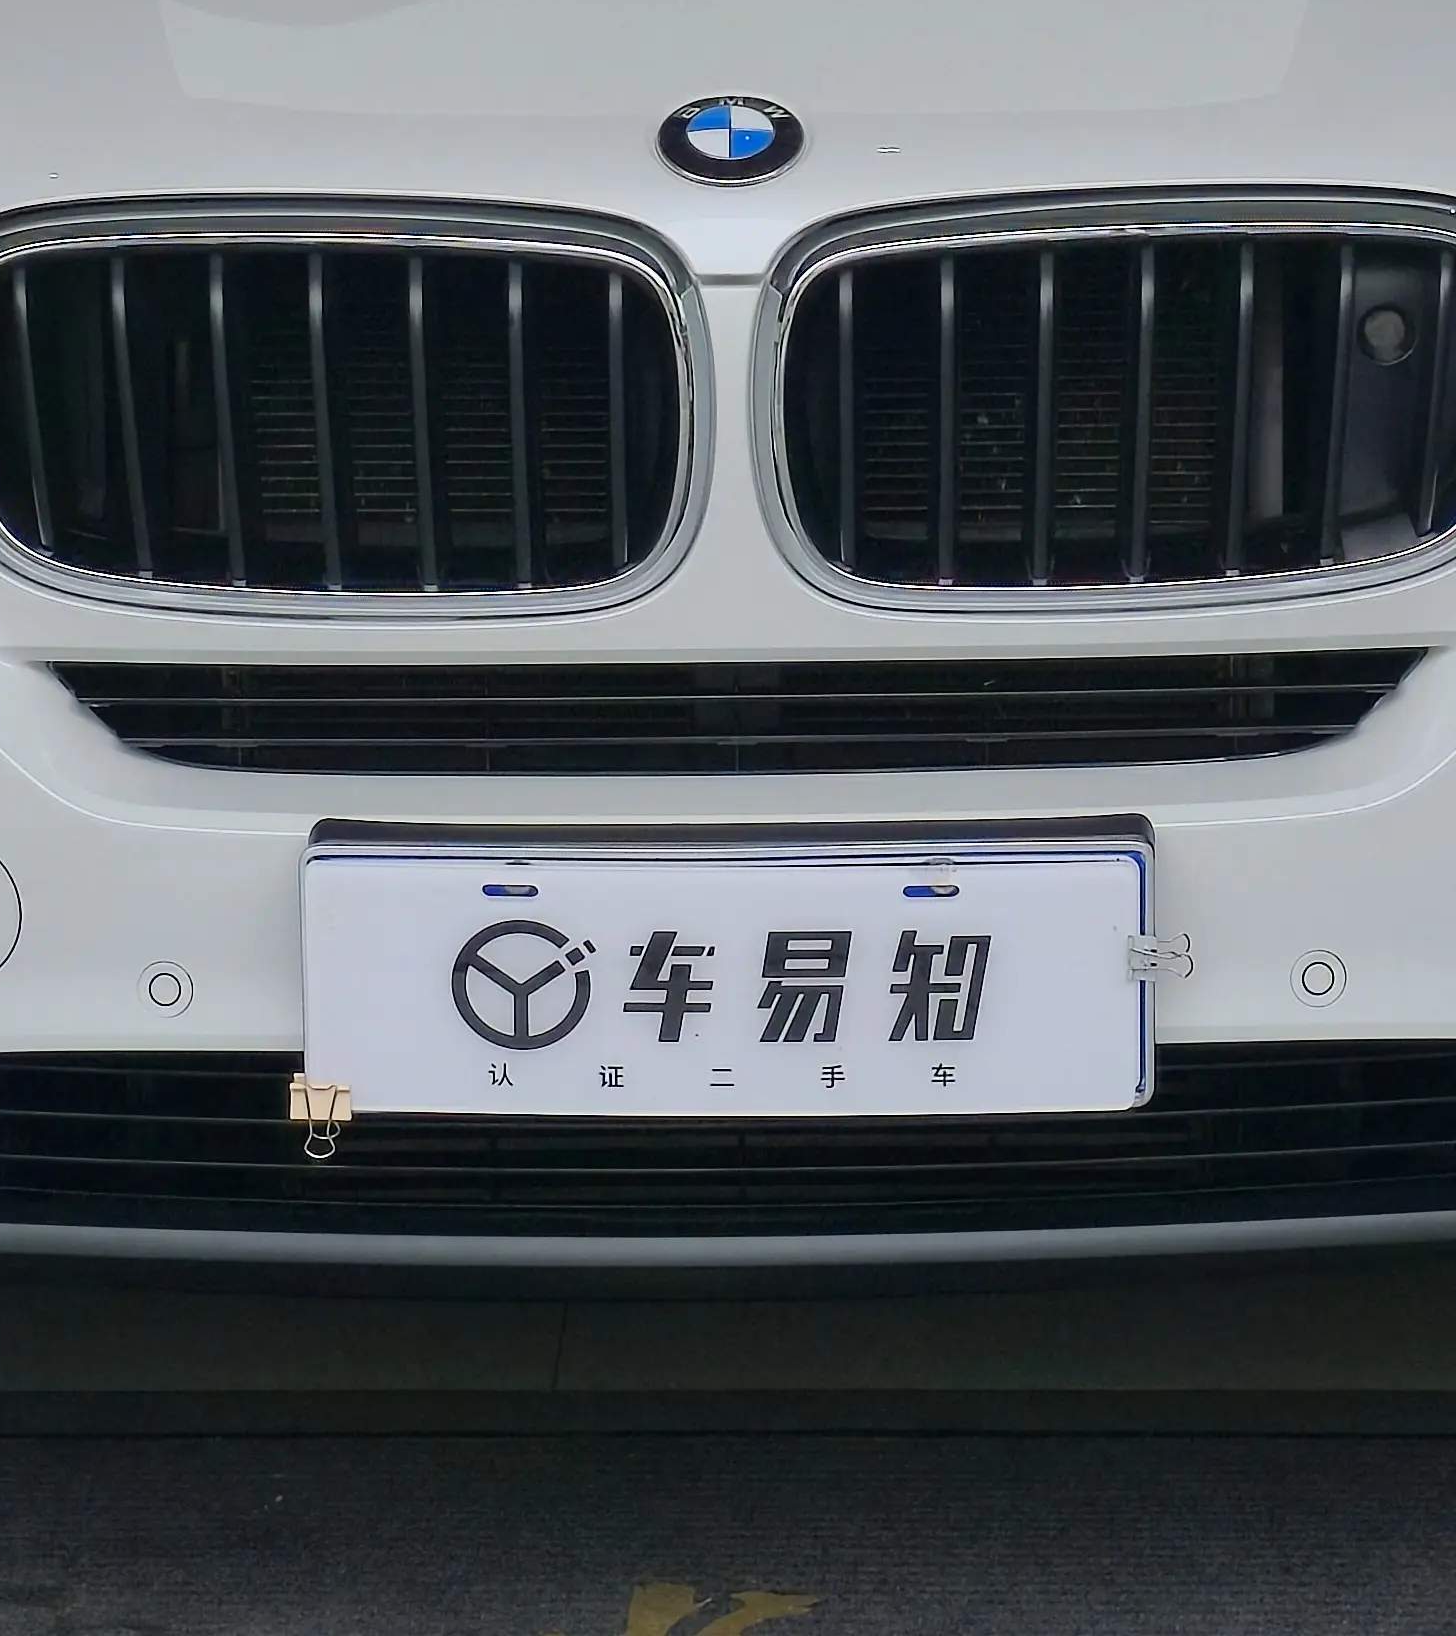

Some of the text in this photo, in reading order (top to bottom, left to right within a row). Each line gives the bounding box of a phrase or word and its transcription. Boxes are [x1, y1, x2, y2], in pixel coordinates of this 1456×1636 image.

[674, 95, 791, 120] BMW
[622, 929, 992, 1044] 车易知
[487, 1062, 958, 1090] 认证二手车
